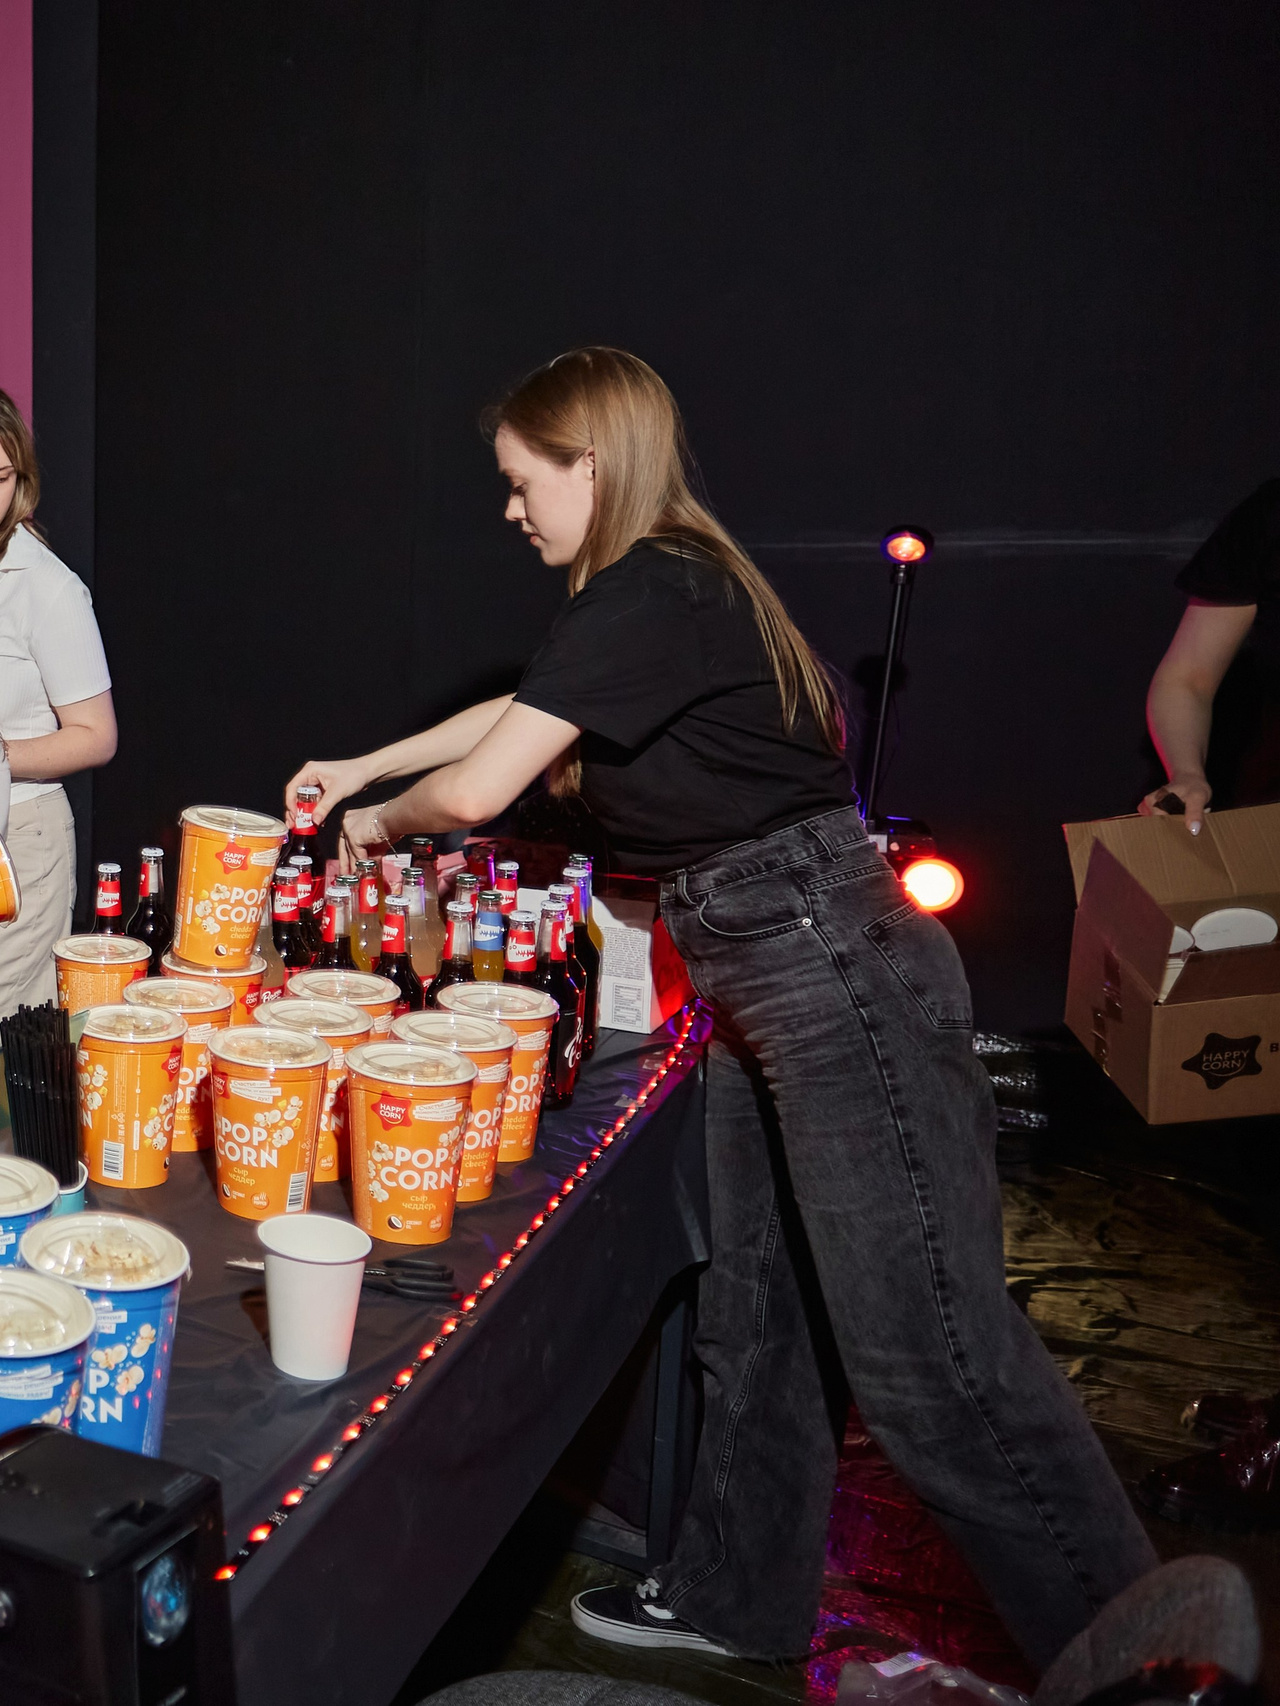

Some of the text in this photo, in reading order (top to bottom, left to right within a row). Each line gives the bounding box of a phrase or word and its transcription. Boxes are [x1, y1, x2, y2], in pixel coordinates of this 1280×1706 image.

[223, 857, 242, 865] CORN
[224, 851, 246, 860] HAPPY
[230, 887, 267, 906] POP
[1203, 1049, 1250, 1062] HAPPY
[1202, 1060, 1241, 1071] CORN
[179, 1067, 208, 1085] OP
[510, 1073, 540, 1094] OP
[380, 1103, 406, 1114] HAPPY
[504, 1090, 541, 1113] ORN
[320, 1112, 345, 1132] RN
[379, 1109, 402, 1120] CORN
[221, 1117, 268, 1146] POP
[464, 1128, 500, 1150] ORN
[217, 1135, 278, 1169] CORN
[394, 1146, 449, 1169] POP
[228, 1172, 256, 1187] чеддер
[233, 1167, 249, 1177] сыр
[380, 1166, 454, 1191] CORN
[402, 1202, 434, 1211] чеддер
[410, 1195, 428, 1203] сыр
[80, 1397, 123, 1424] RN
